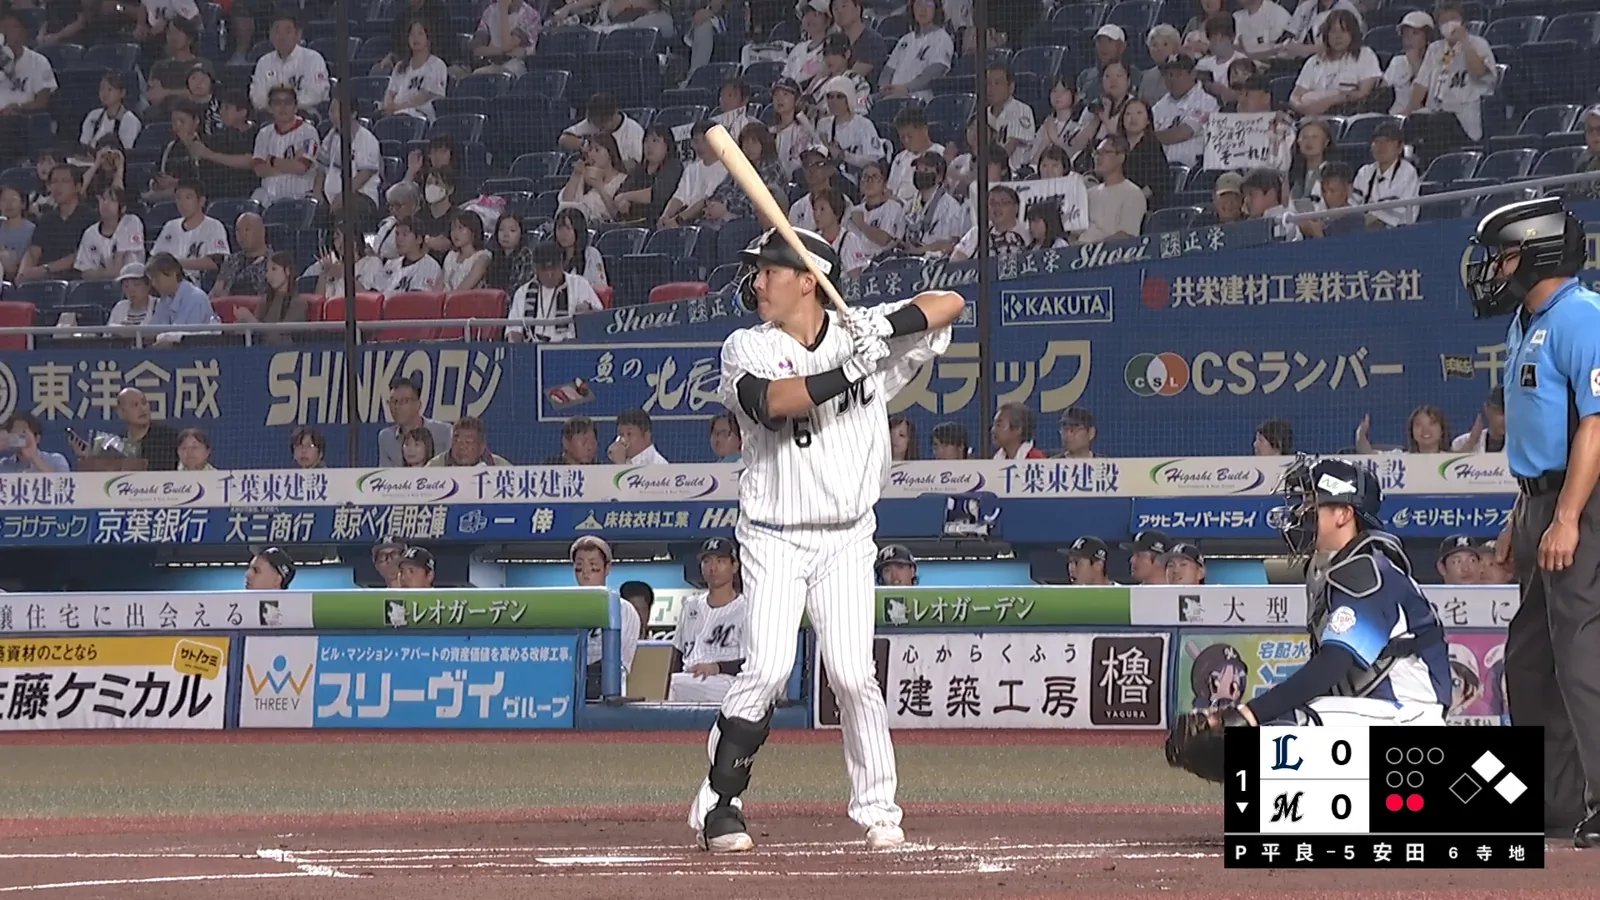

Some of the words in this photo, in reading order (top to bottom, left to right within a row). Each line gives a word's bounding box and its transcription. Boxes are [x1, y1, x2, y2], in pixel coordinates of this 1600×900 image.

[1020, 250, 1061, 274] 正栄
[1070, 237, 1151, 270] Shoei
[913, 263, 978, 291] Shoe
[1171, 269, 1424, 308] 共栄建材工業株式会社
[606, 303, 681, 335] Shoei
[1026, 294, 1104, 316] KAKUTA
[1191, 346, 1404, 396] CSランバー
[28, 359, 221, 420] 東洋合成
[369, 477, 412, 492] Higashi
[416, 476, 446, 490] Build
[470, 469, 585, 500] 千葉東建設
[627, 473, 670, 489] Higashi
[675, 473, 705, 487] Build
[891, 471, 936, 488] Higashi
[940, 471, 971, 485] Build
[997, 462, 1120, 493] 千葉東建設
[1164, 467, 1213, 484] Higashi
[1216, 467, 1251, 481] Build
[1454, 463, 1505, 480] Higashi
[117, 481, 159, 496] Higashi
[162, 481, 193, 494] Build
[217, 473, 328, 503] 千葉東建設
[94, 508, 208, 544] 京葉銀行
[225, 512, 315, 542] 大三商行
[331, 505, 448, 540] 東京ベイ信用金庫
[412, 599, 528, 624] レオガーデン
[912, 597, 1036, 623] レオガーデン
[704, 625, 736, 649] M
[0, 644, 98, 662] 資材のことなら
[901, 642, 1078, 664] 心からくふう
[1099, 645, 1154, 706] 櫓
[0, 671, 213, 720] 藤ケミカル
[254, 697, 288, 711] THREE
[291, 697, 299, 711] V
[897, 674, 1079, 718] 建築工房
[1104, 710, 1147, 719] YAGURA
